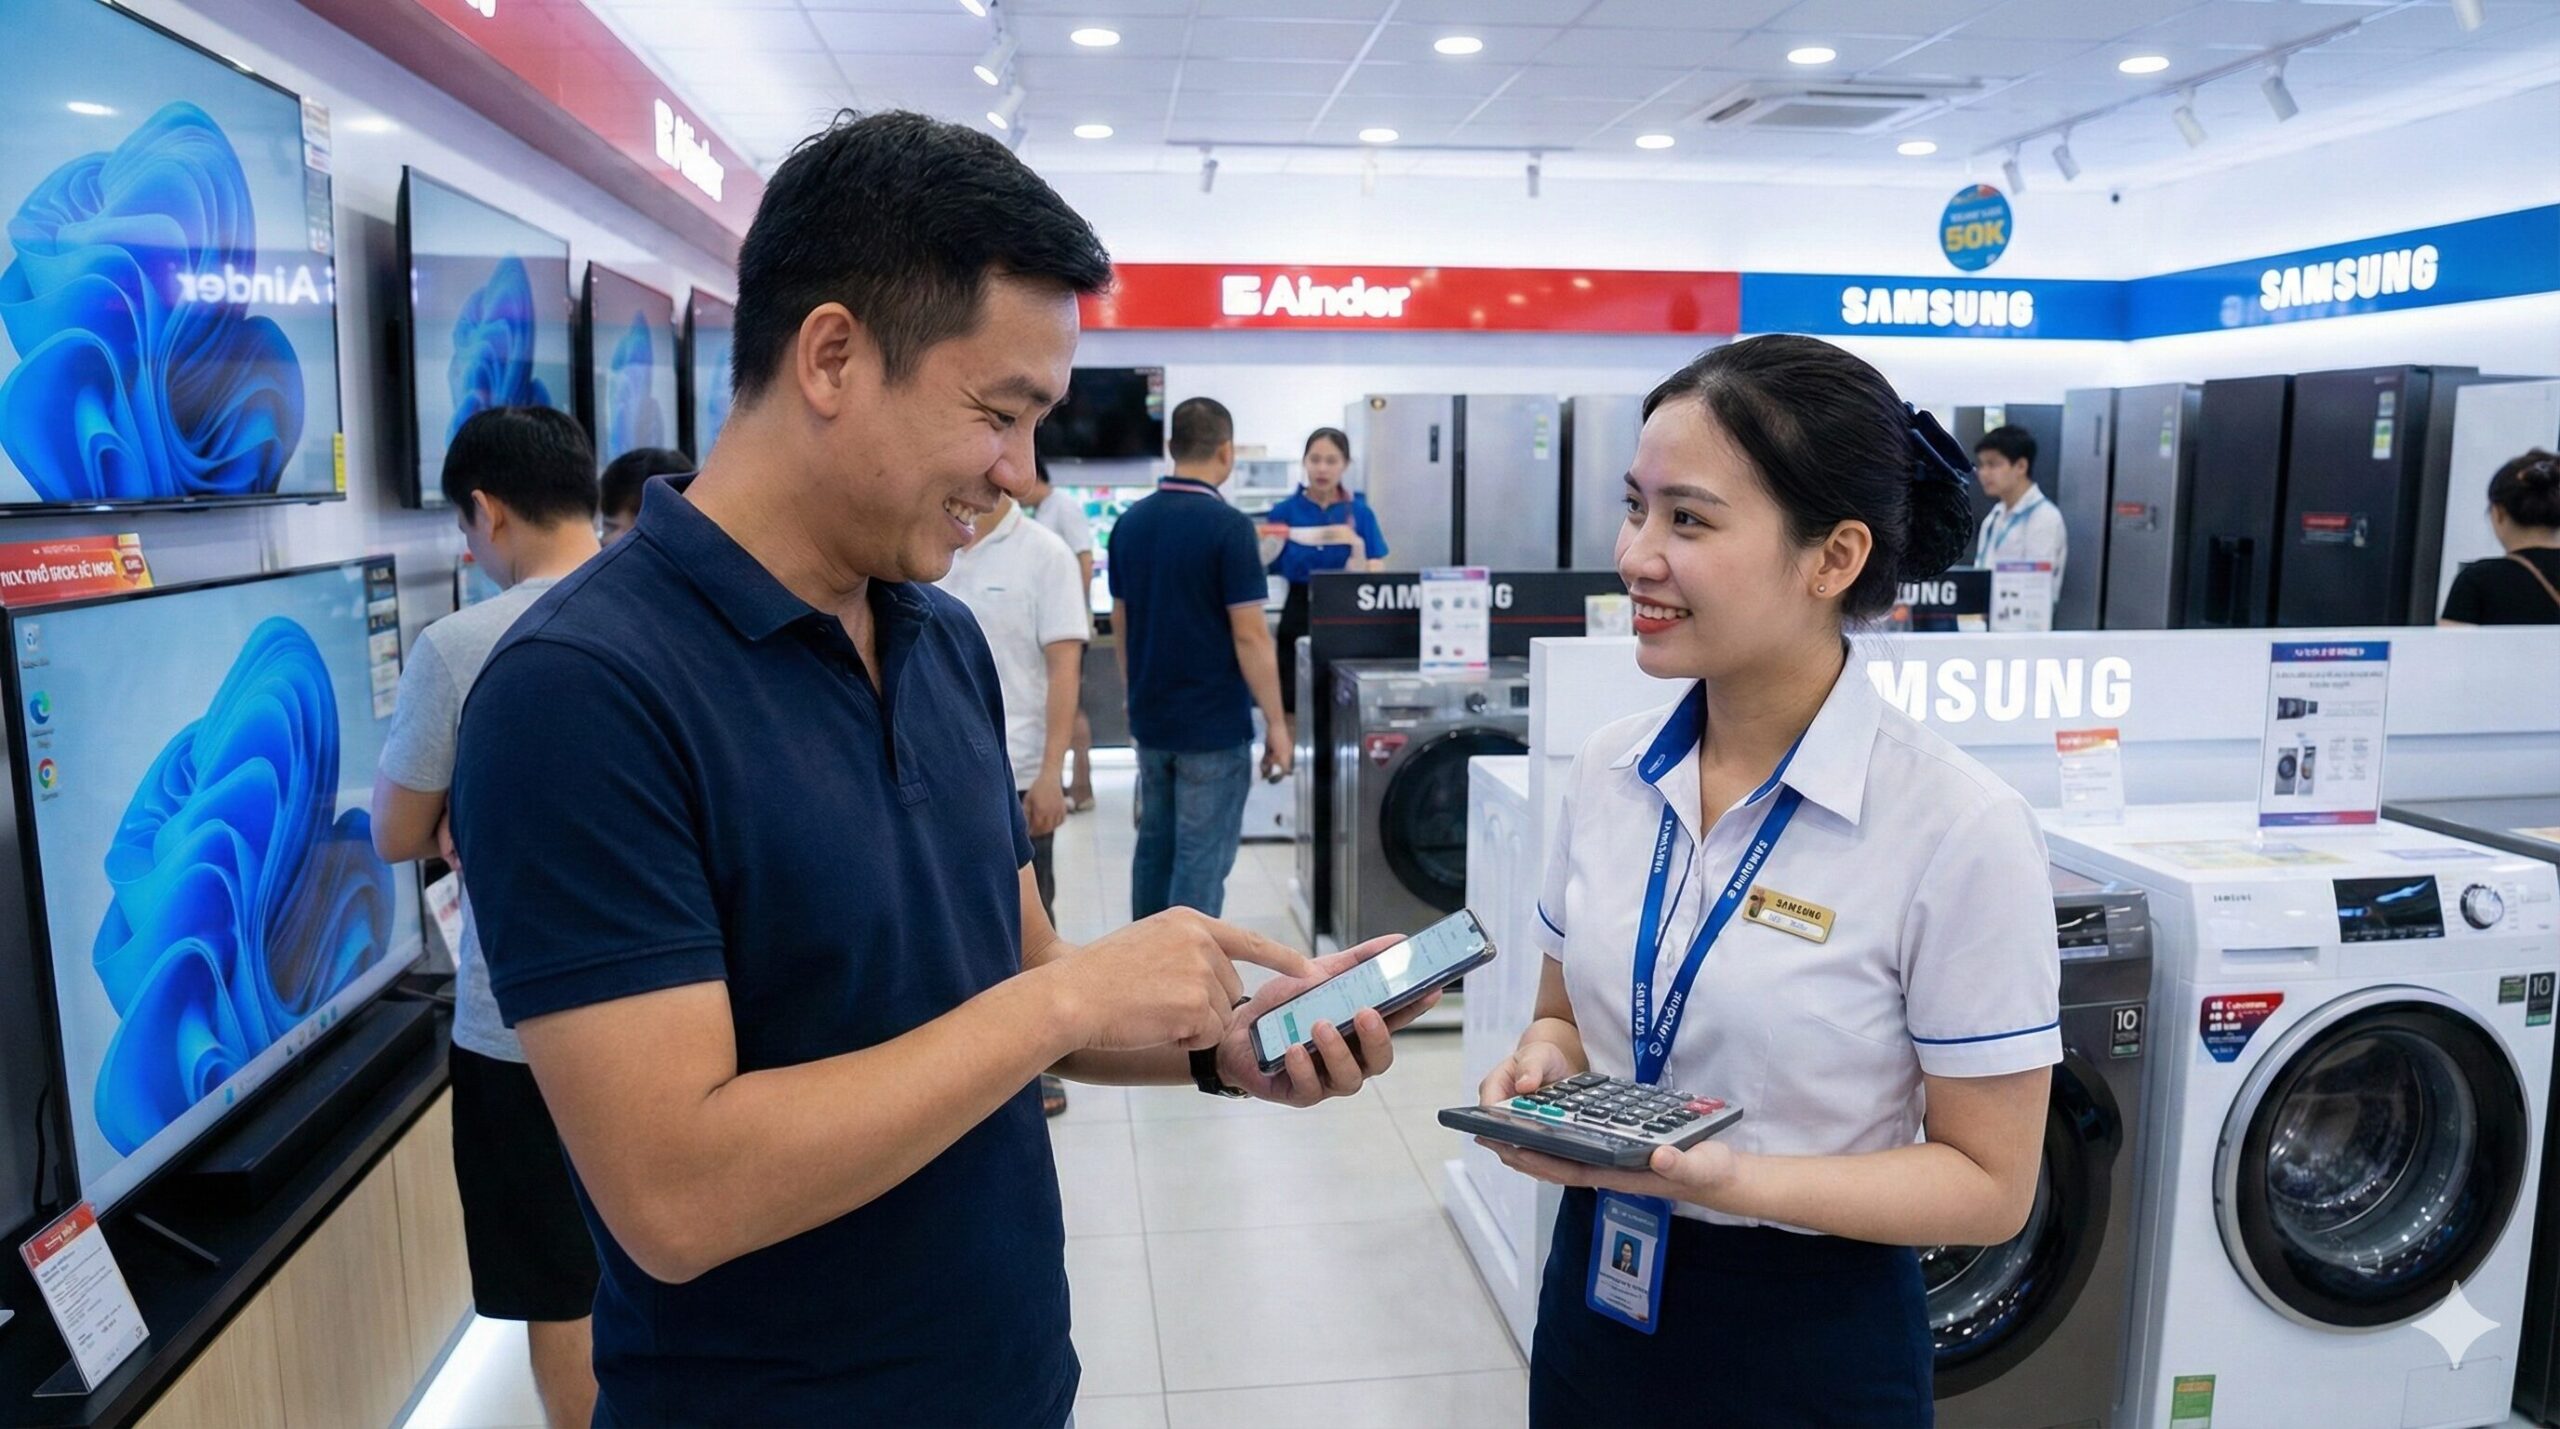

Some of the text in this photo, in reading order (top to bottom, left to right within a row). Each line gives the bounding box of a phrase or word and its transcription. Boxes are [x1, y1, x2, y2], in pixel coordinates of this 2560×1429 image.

[1946, 220, 2005, 252] 50K
[1262, 275, 1411, 317] Ainder
[2259, 245, 2438, 311] SAMSUNG
[1842, 286, 2033, 328] SAMSUNG
[2534, 975, 2550, 997] 10
[2116, 1010, 2137, 1030] 10
